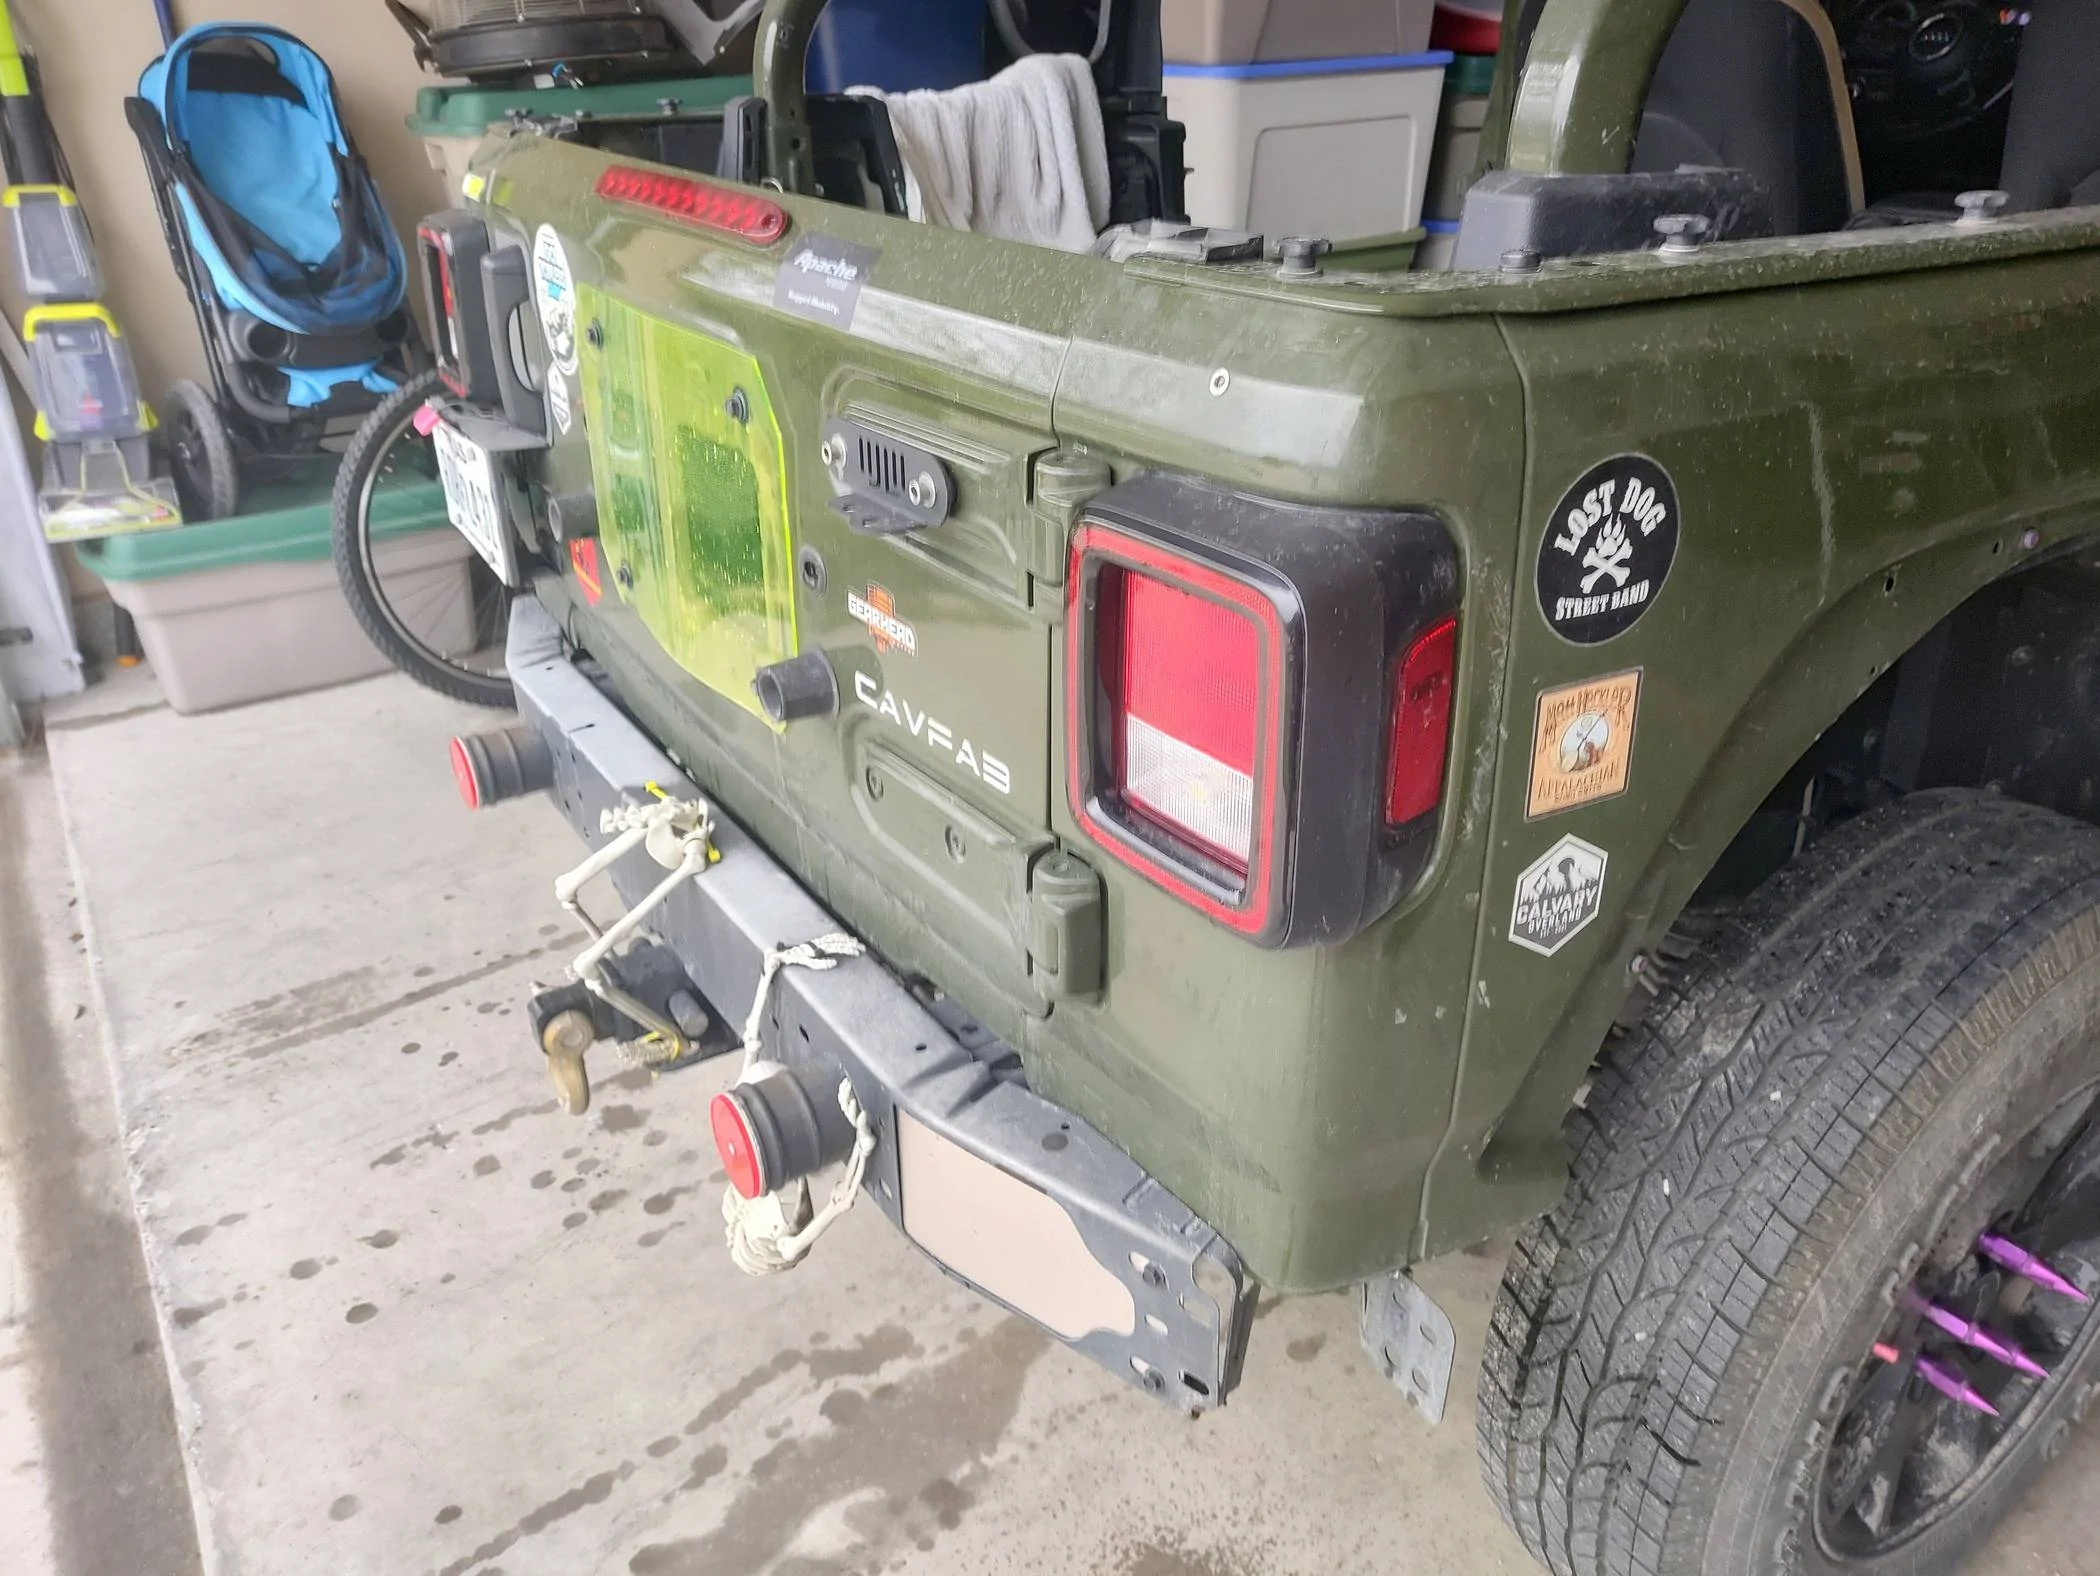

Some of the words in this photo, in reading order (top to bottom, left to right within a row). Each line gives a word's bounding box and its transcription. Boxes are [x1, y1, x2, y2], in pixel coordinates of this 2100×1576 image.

[793, 248, 858, 281] Apache
[1553, 478, 1616, 557] LOST
[1619, 476, 1667, 537] DOG
[848, 590, 916, 652] GEARHEAD
[1554, 593, 1610, 621] STREET
[1610, 578, 1650, 611] BAND
[854, 669, 1011, 795] CAVFAB
[1516, 885, 1598, 925] CALVARY
[1528, 908, 1583, 934] OVERLAND
